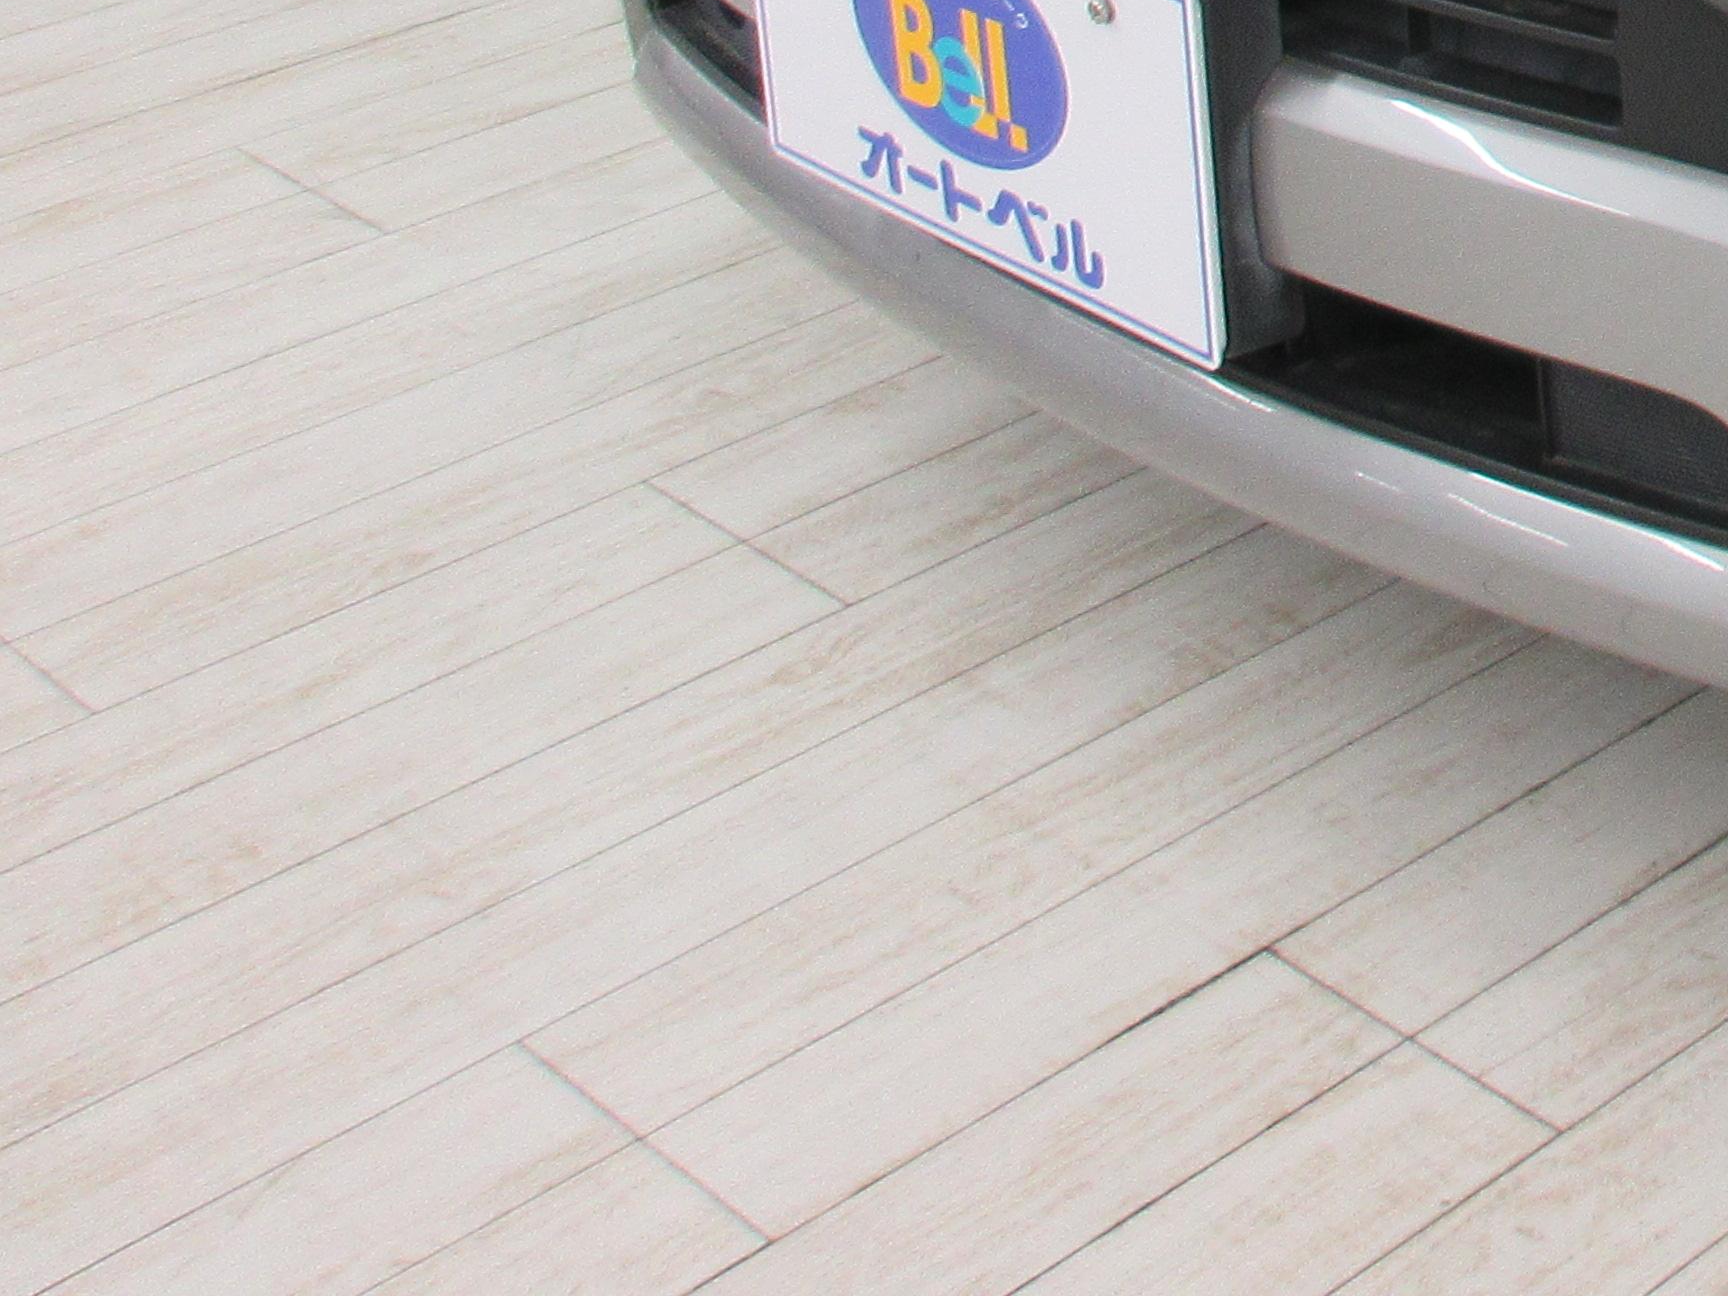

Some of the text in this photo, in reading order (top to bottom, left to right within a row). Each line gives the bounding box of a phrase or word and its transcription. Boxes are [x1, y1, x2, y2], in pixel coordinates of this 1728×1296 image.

[858, 125, 1104, 290] オートベル
